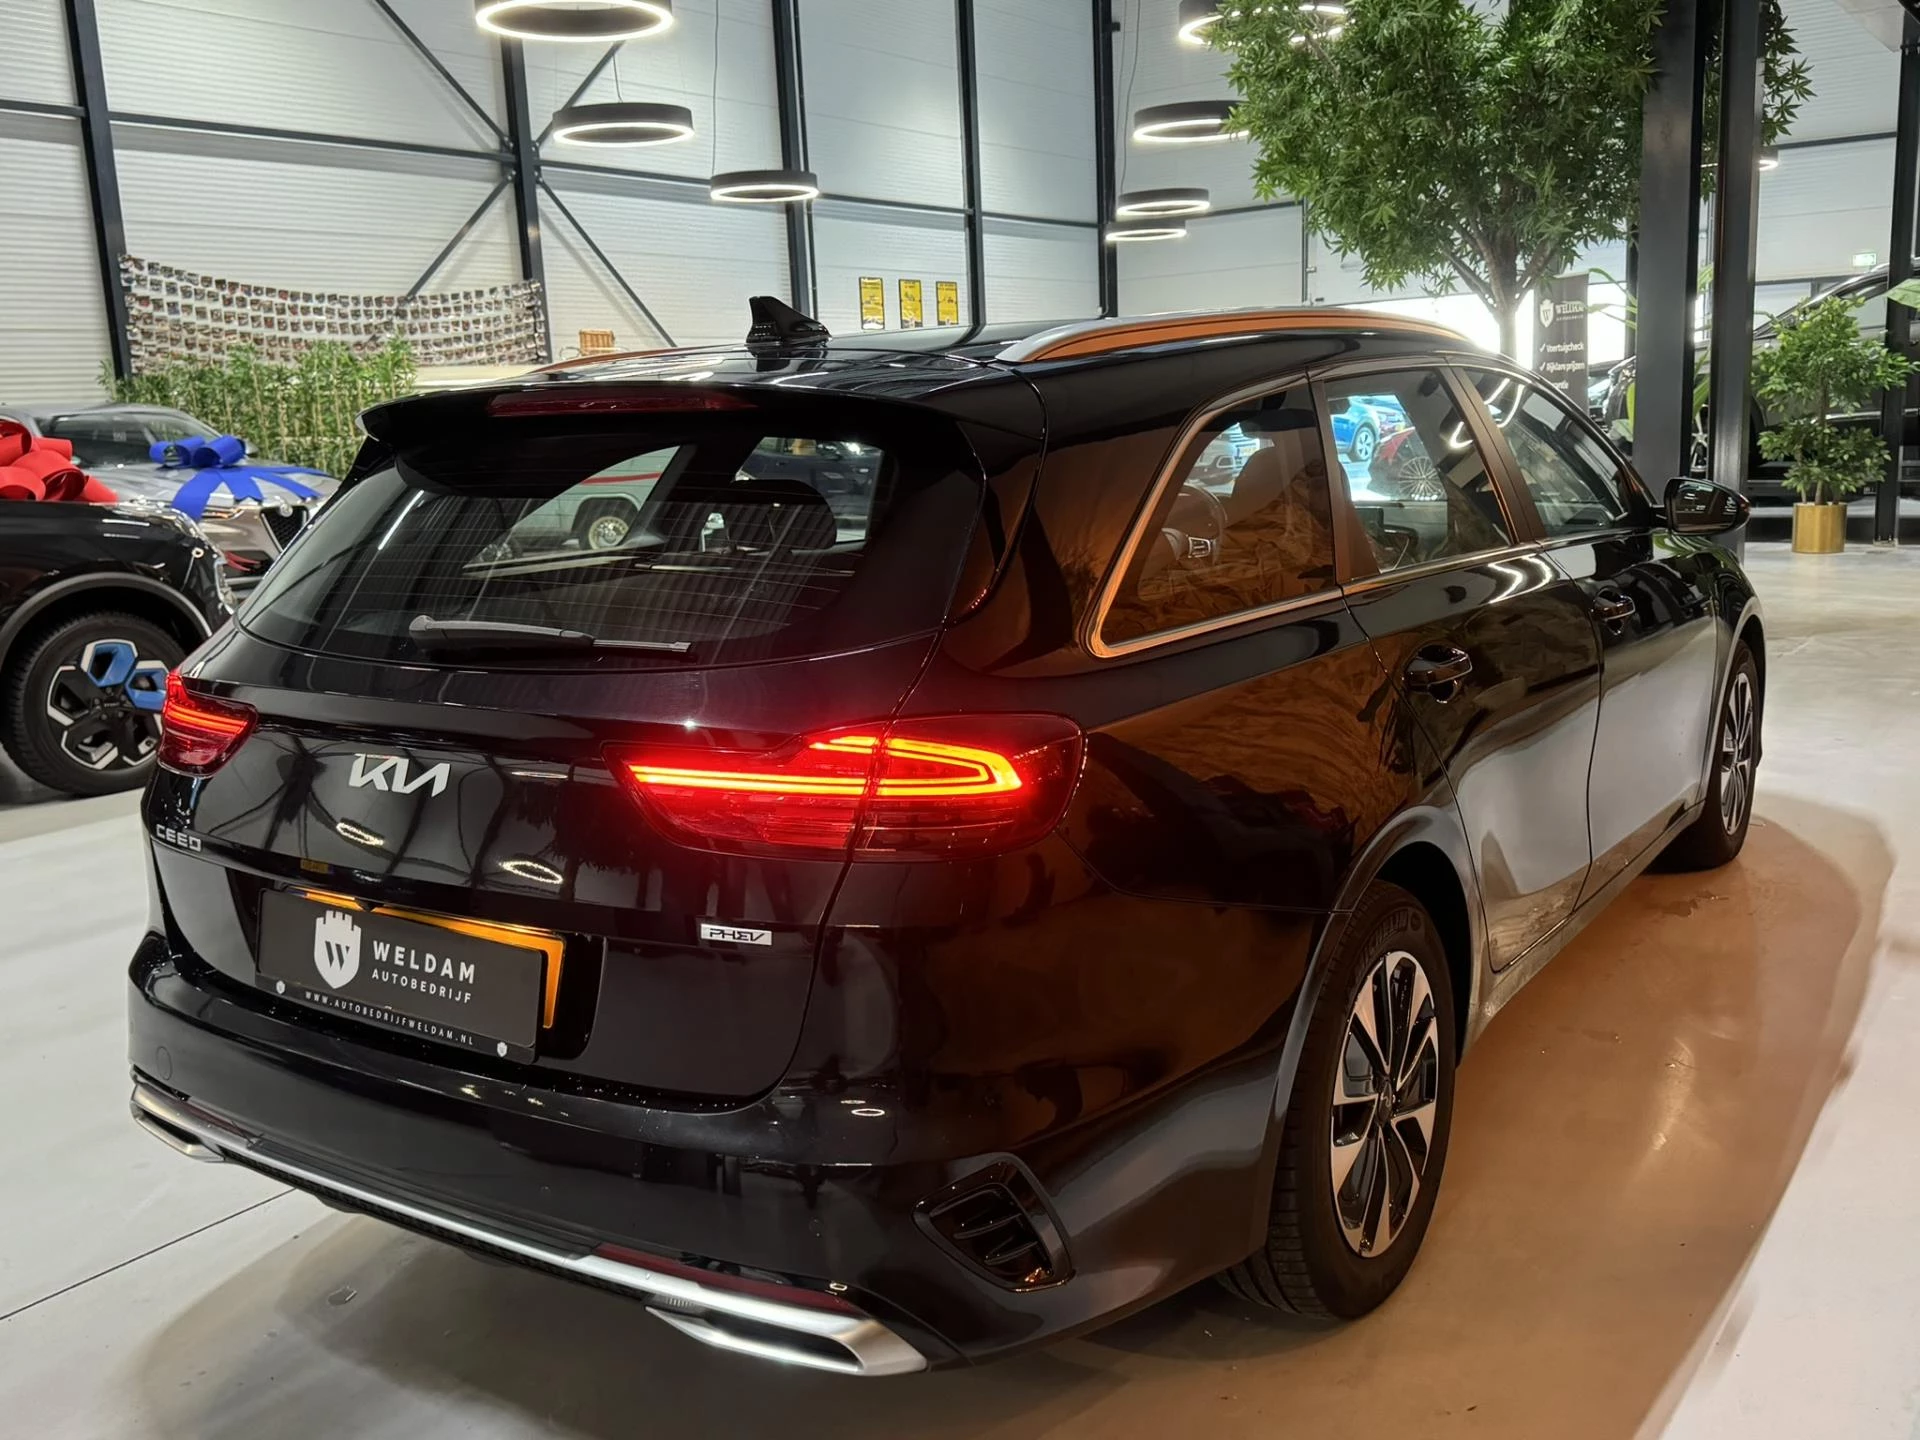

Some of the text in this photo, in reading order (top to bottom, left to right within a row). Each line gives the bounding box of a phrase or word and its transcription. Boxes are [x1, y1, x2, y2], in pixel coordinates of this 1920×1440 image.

[349, 753, 451, 798] KIA
[156, 824, 202, 852] CEED
[709, 927, 765, 942] PHEV
[372, 940, 475, 985] WELDAM
[372, 968, 472, 1004] AUTOBEDRIJF
[305, 991, 474, 1046] WWW.AUTOBEDRIJFWELDAM.NL
